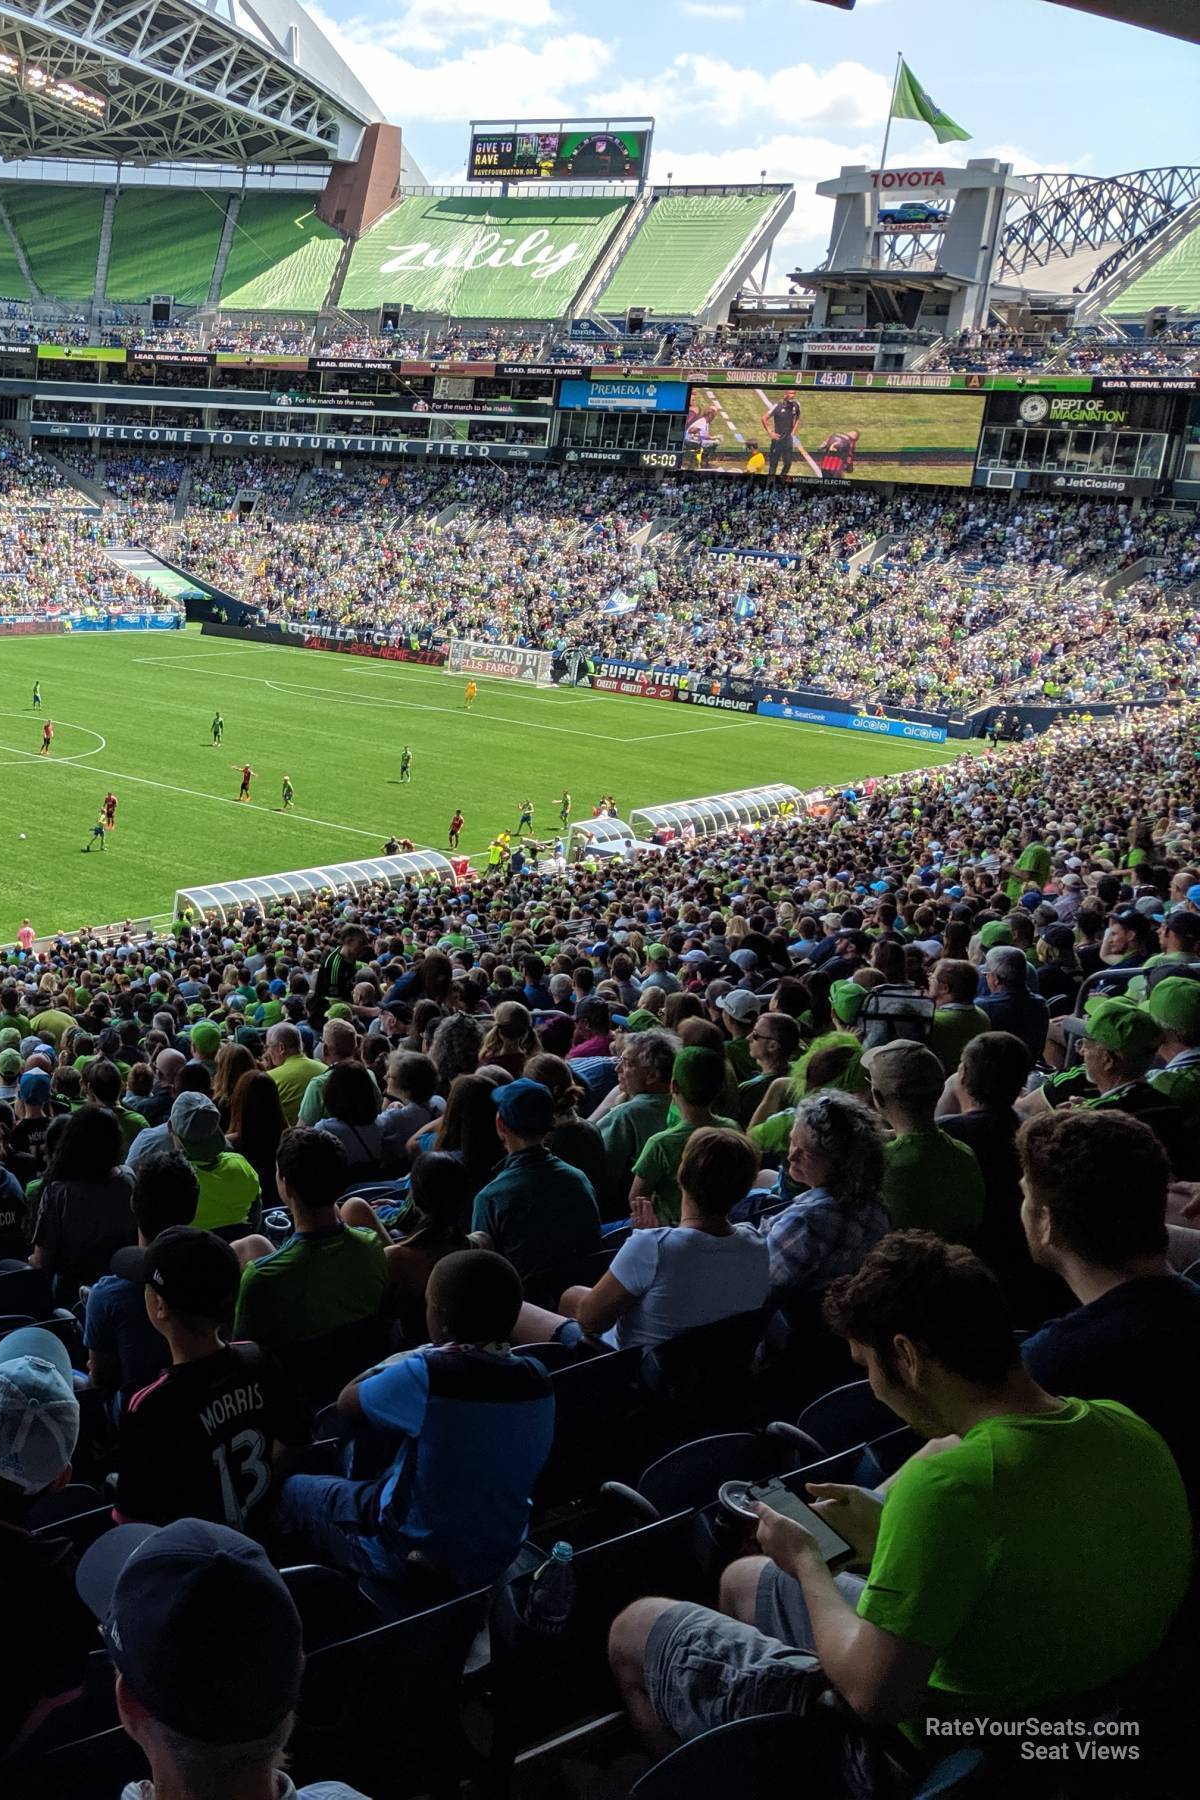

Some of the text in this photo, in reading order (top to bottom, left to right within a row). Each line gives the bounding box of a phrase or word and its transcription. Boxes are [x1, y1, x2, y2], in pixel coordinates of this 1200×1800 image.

[476, 142, 512, 153] GIVE TO
[475, 154, 499, 165] RAVE
[871, 170, 945, 188] TOYOTA
[379, 230, 586, 278] zulily
[7, 345, 31, 353] INVEST.
[554, 368, 582, 376] INVEST.
[726, 371, 766, 382] SOUNDERS
[767, 372, 777, 383] FC
[795, 373, 802, 384] 0
[820, 373, 847, 385] 45:00
[866, 374, 873, 385] 0
[886, 375, 921, 386] ATLANTA
[922, 376, 951, 387] UNITED
[1129, 381, 1160, 389] SERVE.
[591, 383, 640, 395] PREMERA
[1052, 398, 1083, 410] DEPT
[1085, 399, 1104, 411] OF
[1050, 409, 1125, 422] IMAGINATION
[88, 426, 490, 457] WELCOME TO CENTURYLINK FIELD
[581, 452, 621, 460] STARBUCKS
[642, 454, 676, 467] 45:00
[1066, 478, 1125, 490] JetClosing
[485, 661, 519, 675] FARGO
[794, 709, 826, 722] SeatGeek
[200, 1383, 264, 1436] MORRIS
[212, 1429, 271, 1526] 13
